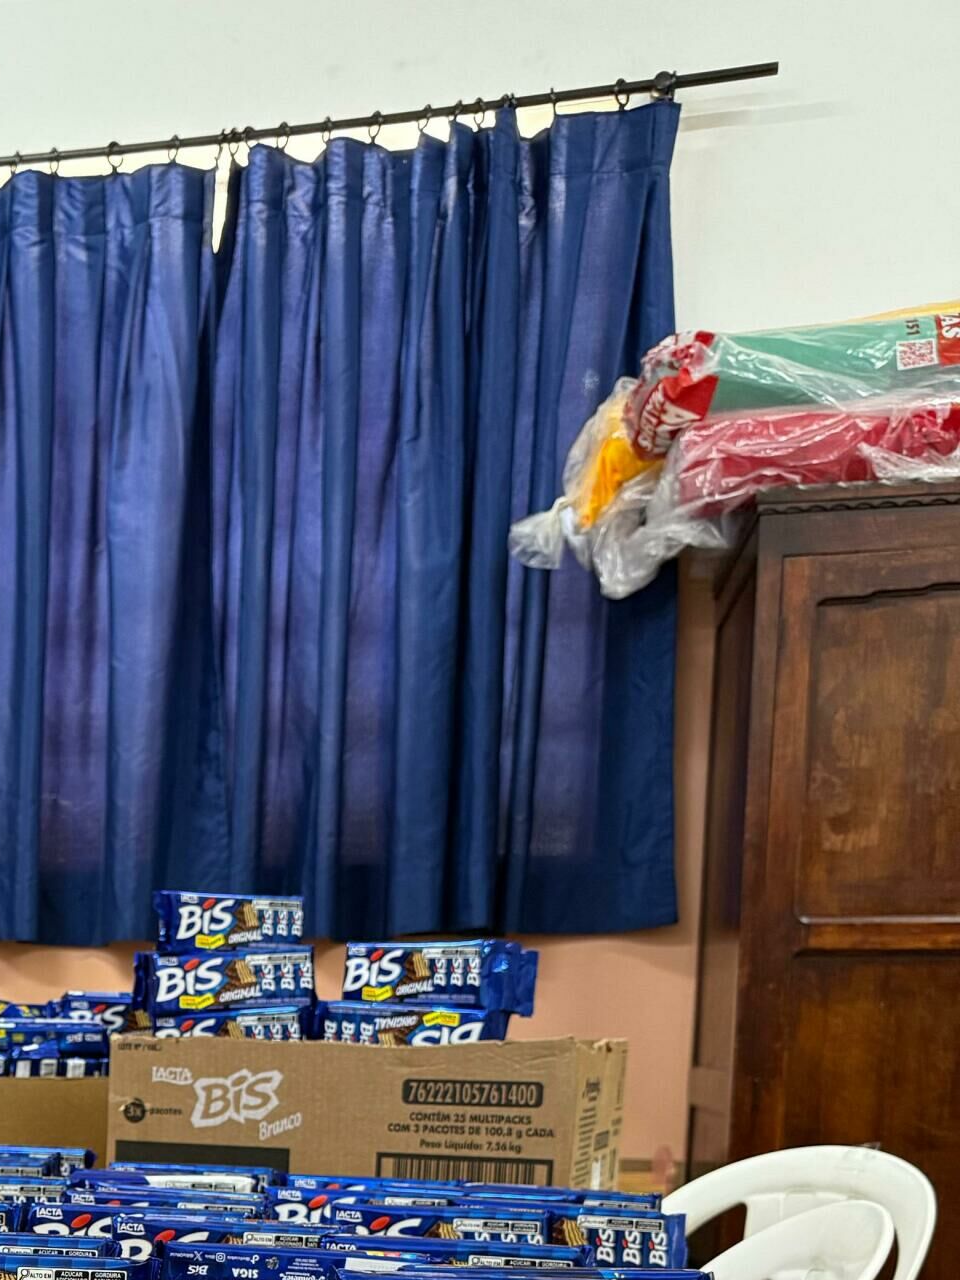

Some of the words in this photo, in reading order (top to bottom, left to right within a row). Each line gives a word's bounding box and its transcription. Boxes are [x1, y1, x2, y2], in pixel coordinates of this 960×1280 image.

[152, 1066, 192, 1083] LACTA
[408, 1081, 537, 1106] 76222105761400
[469, 1113, 532, 1125] MULTIPACKS
[258, 1112, 302, 1141] Branco
[387, 1122, 410, 1133] COM
[422, 1124, 466, 1136] PACOTES
[468, 1126, 481, 1136] DE
[117, 1222, 145, 1234] LACTA
[232, 1267, 258, 1279] SIGA
